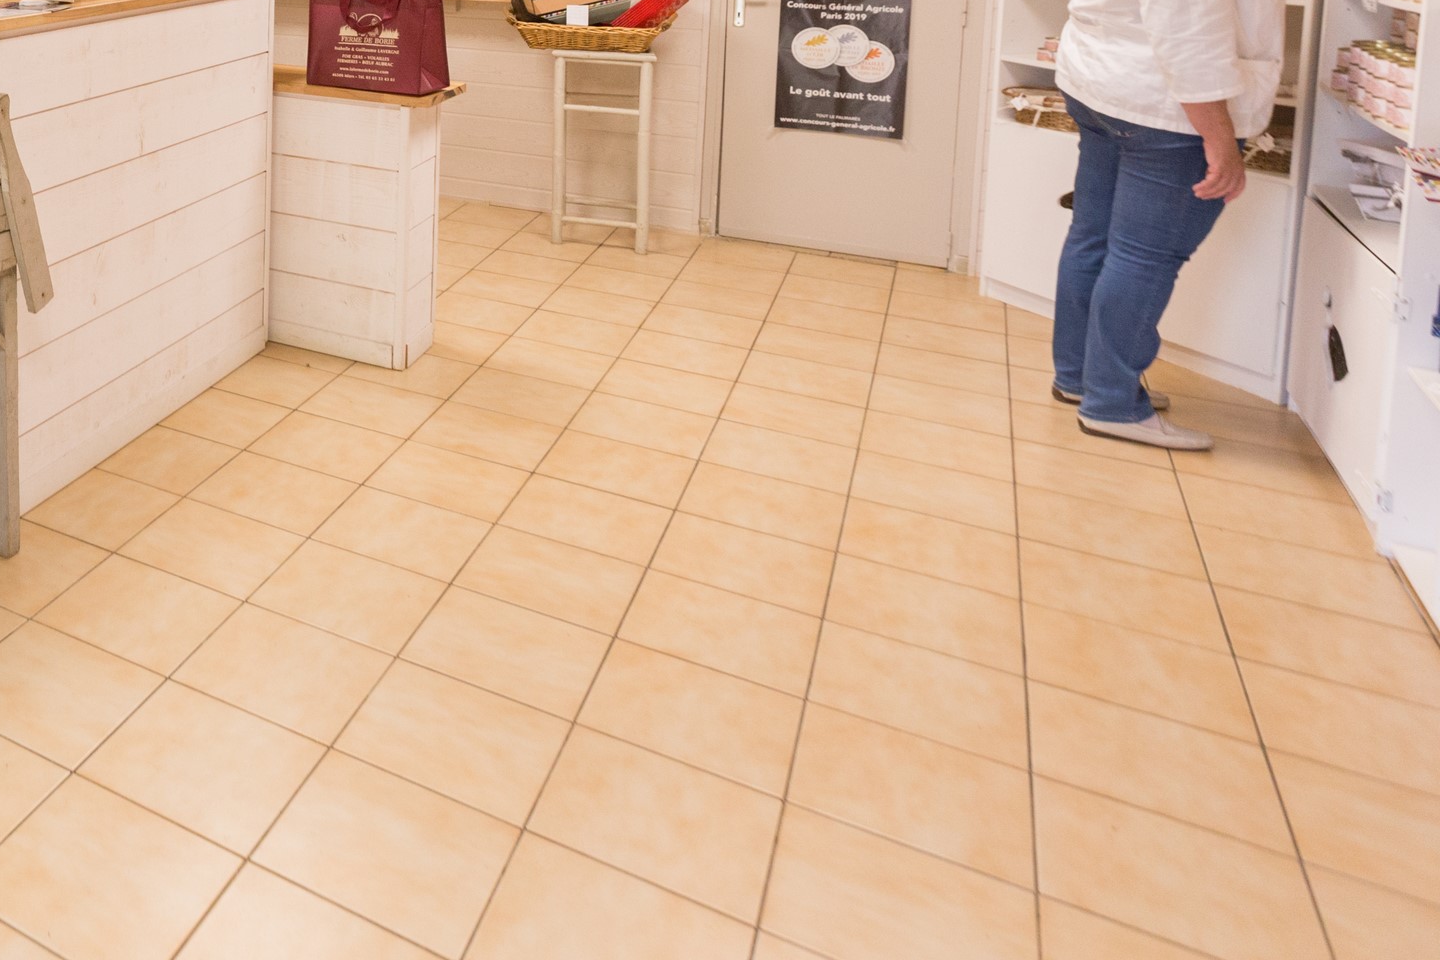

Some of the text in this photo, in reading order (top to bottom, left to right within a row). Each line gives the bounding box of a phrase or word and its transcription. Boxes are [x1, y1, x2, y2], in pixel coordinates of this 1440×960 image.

[786, 1, 904, 15] Concours Général Agricole
[820, 11, 868, 22] Paris 2019
[789, 86, 892, 103] Le goût avant tout
[779, 116, 896, 133] www.concours-general-agricole.fr
